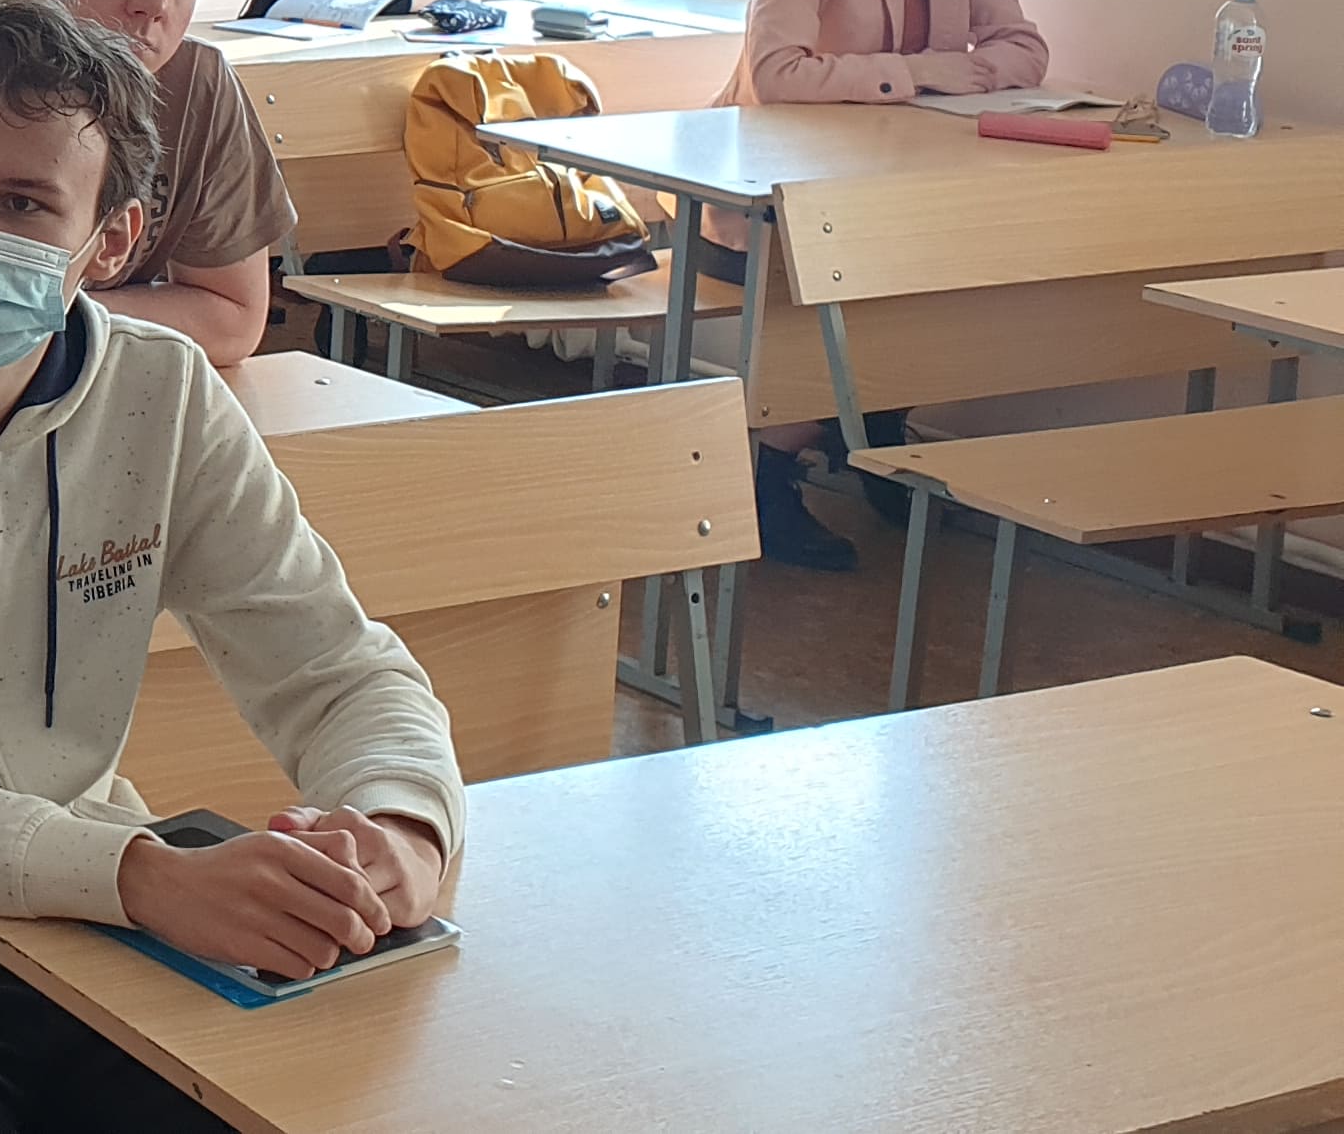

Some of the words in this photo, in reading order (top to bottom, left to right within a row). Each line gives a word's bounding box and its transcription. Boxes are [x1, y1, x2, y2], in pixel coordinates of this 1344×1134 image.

[56, 553, 97, 581] Lake
[101, 523, 162, 566] Baikal
[68, 560, 133, 592] TRAVELING
[137, 553, 153, 567] IN
[83, 574, 135, 603] SIBERIA
